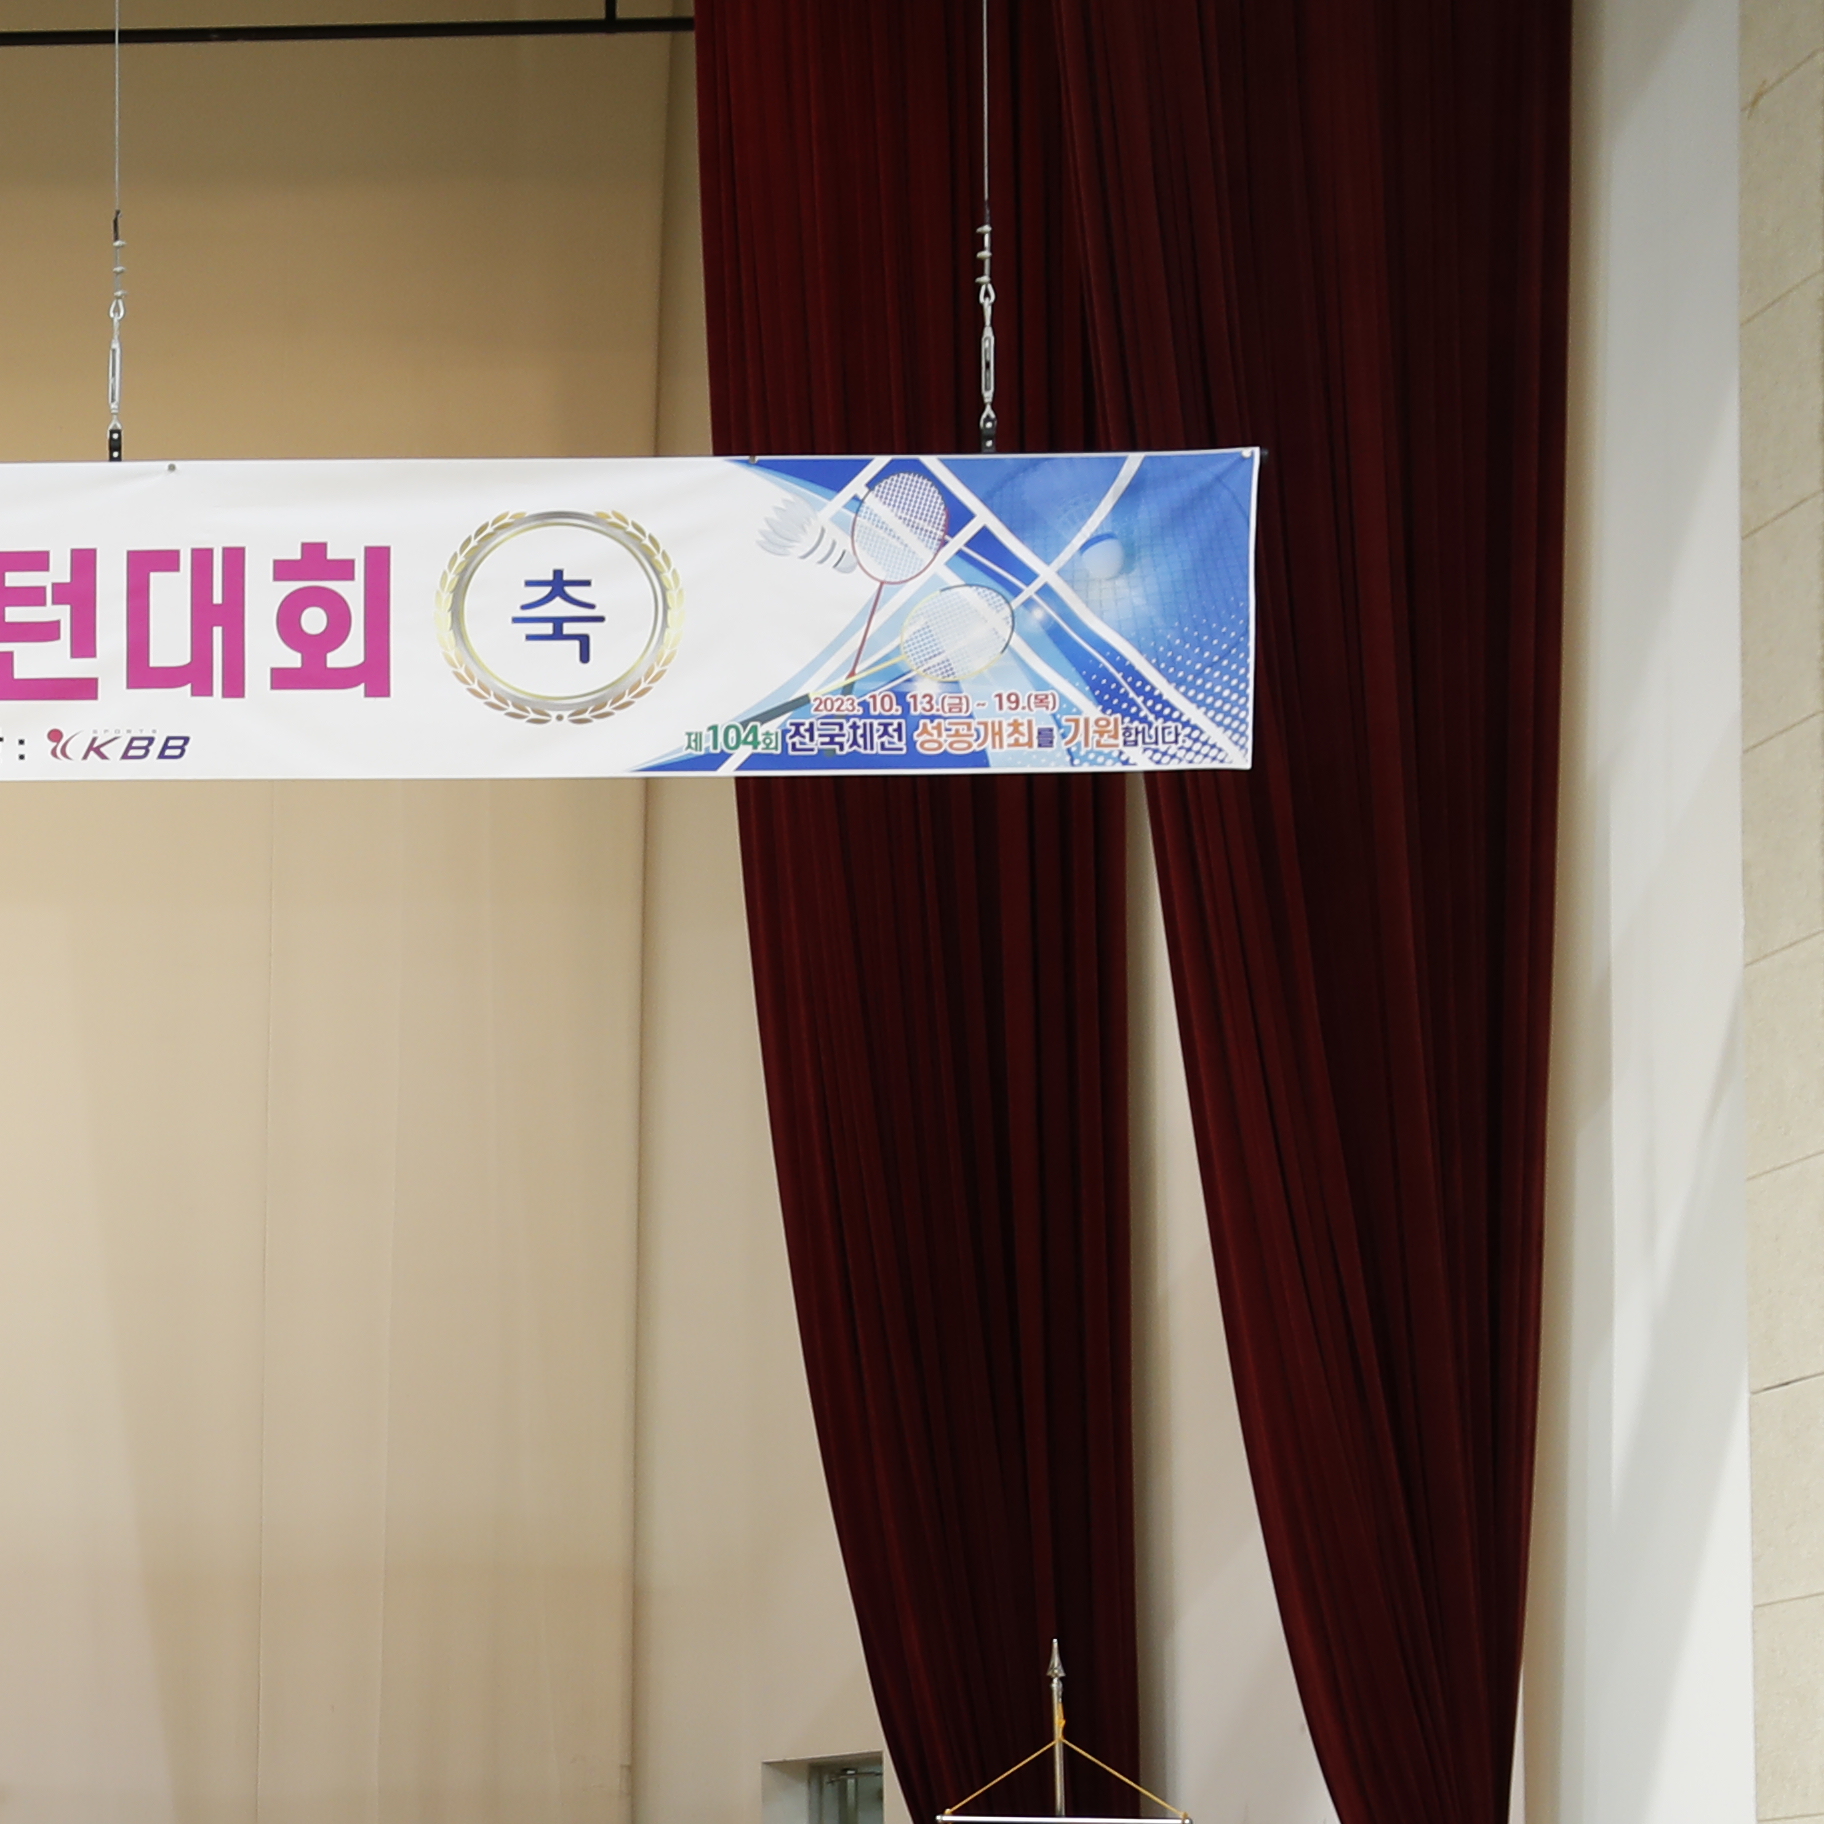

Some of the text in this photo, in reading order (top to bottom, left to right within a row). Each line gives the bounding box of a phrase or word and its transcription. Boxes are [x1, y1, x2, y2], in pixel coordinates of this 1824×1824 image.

[512, 569, 605, 664] 축
[82, 736, 190, 760] KBB
[685, 716, 1182, 754] 제104회 전국체전 성공개최를 기원합니다
